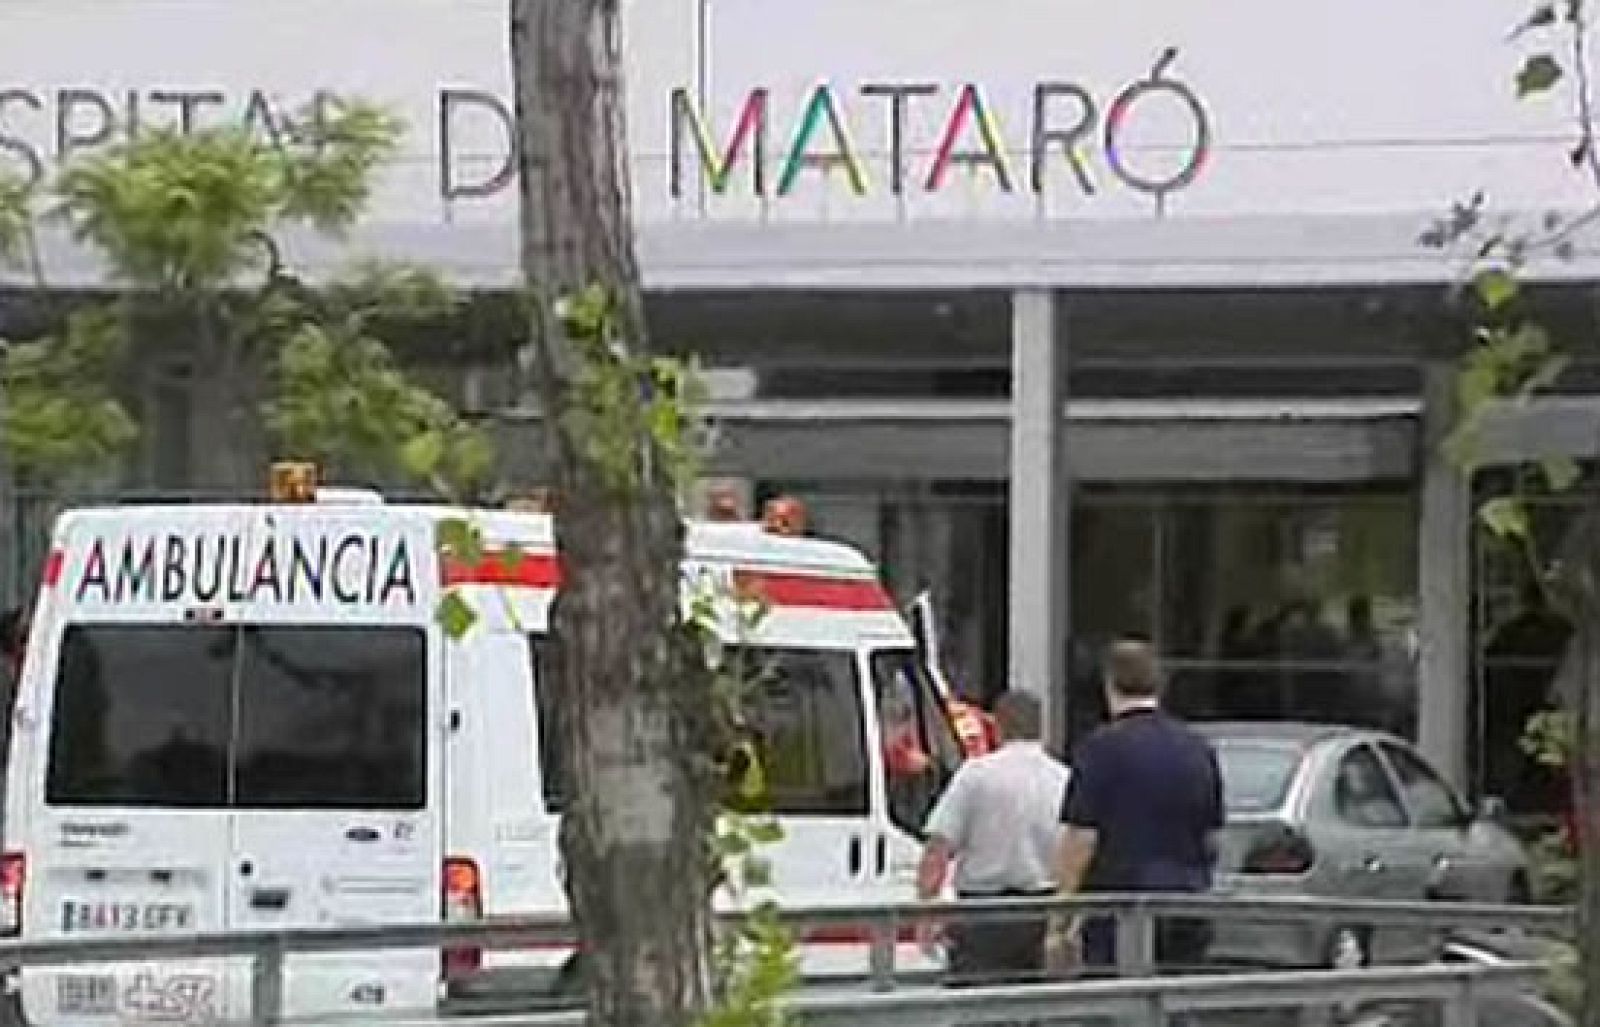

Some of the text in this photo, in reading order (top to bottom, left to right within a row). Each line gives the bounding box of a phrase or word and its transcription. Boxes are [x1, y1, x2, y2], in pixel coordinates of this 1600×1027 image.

[0, 88, 346, 197] SPITA
[671, 46, 1211, 196] MATARÓ
[76, 514, 416, 605] AMBULÀNCIA
